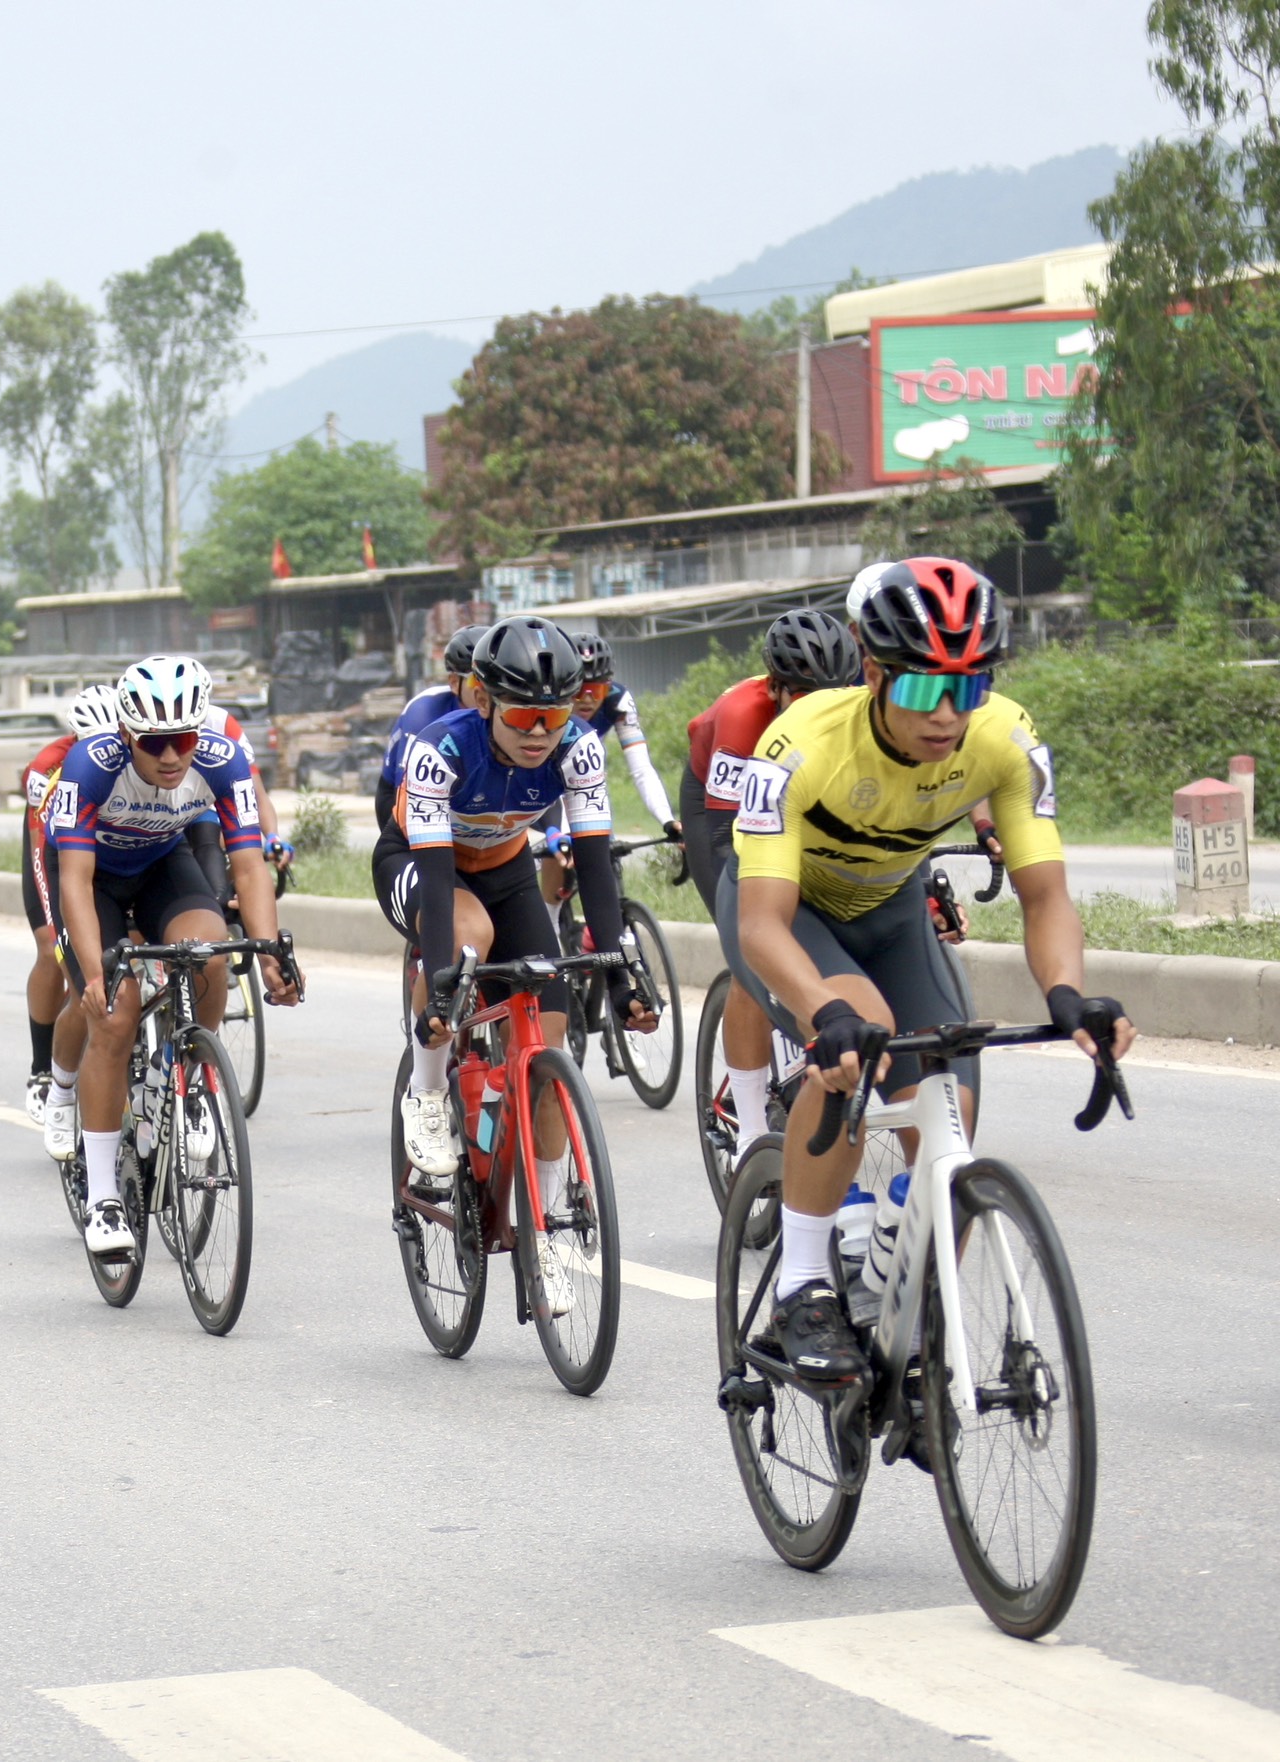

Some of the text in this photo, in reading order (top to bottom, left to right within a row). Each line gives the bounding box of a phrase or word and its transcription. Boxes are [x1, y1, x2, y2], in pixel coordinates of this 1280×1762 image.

[894, 358, 1008, 405] TÔN
[415, 753, 446, 785] 66
[572, 742, 601, 776] 66
[714, 761, 744, 789] 97
[1177, 856, 1191, 875] 440
[1203, 860, 1242, 881] 440
[180, 974, 193, 1022] GIANT
[944, 1082, 963, 1142] GIANT
